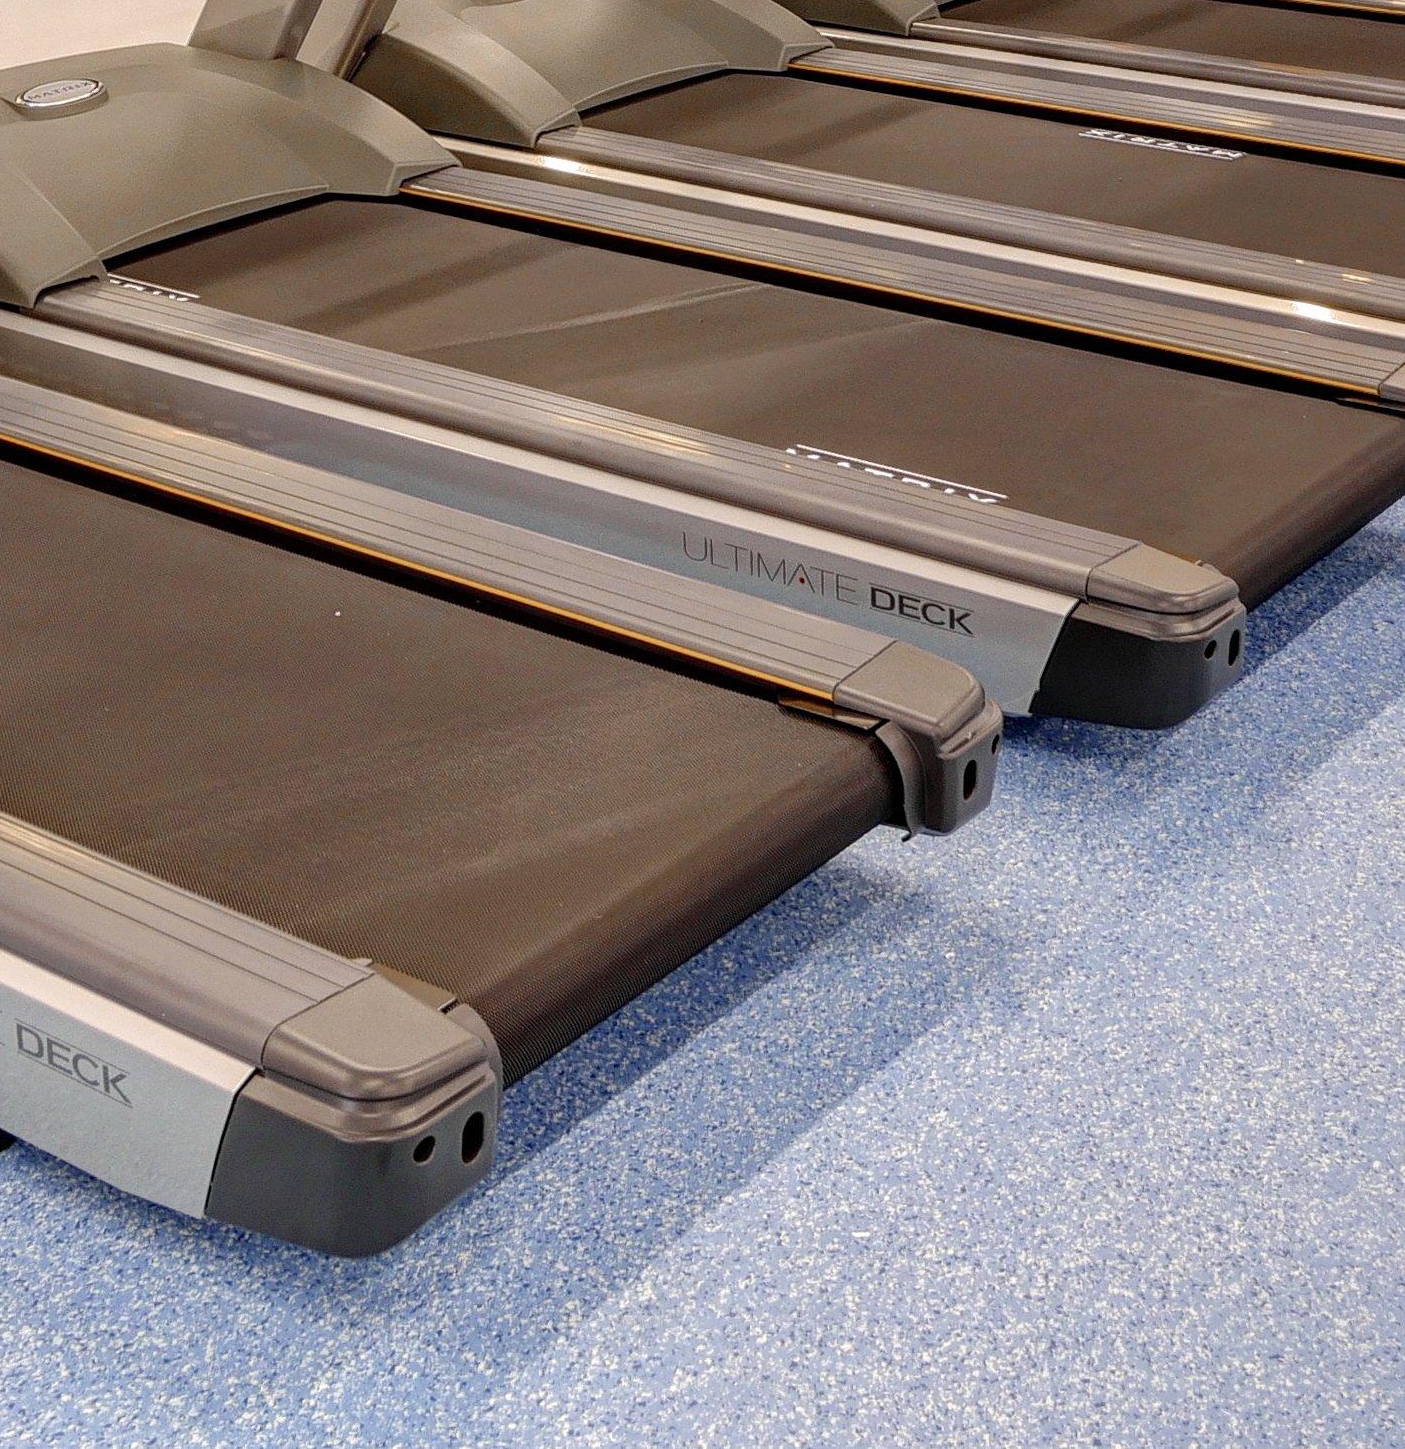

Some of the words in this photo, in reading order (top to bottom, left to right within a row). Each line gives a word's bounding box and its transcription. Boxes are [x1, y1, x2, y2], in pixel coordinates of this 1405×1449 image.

[682, 531, 859, 606] ULTIMATE
[869, 585, 975, 635] DECK
[15, 1021, 132, 1107] DECK
